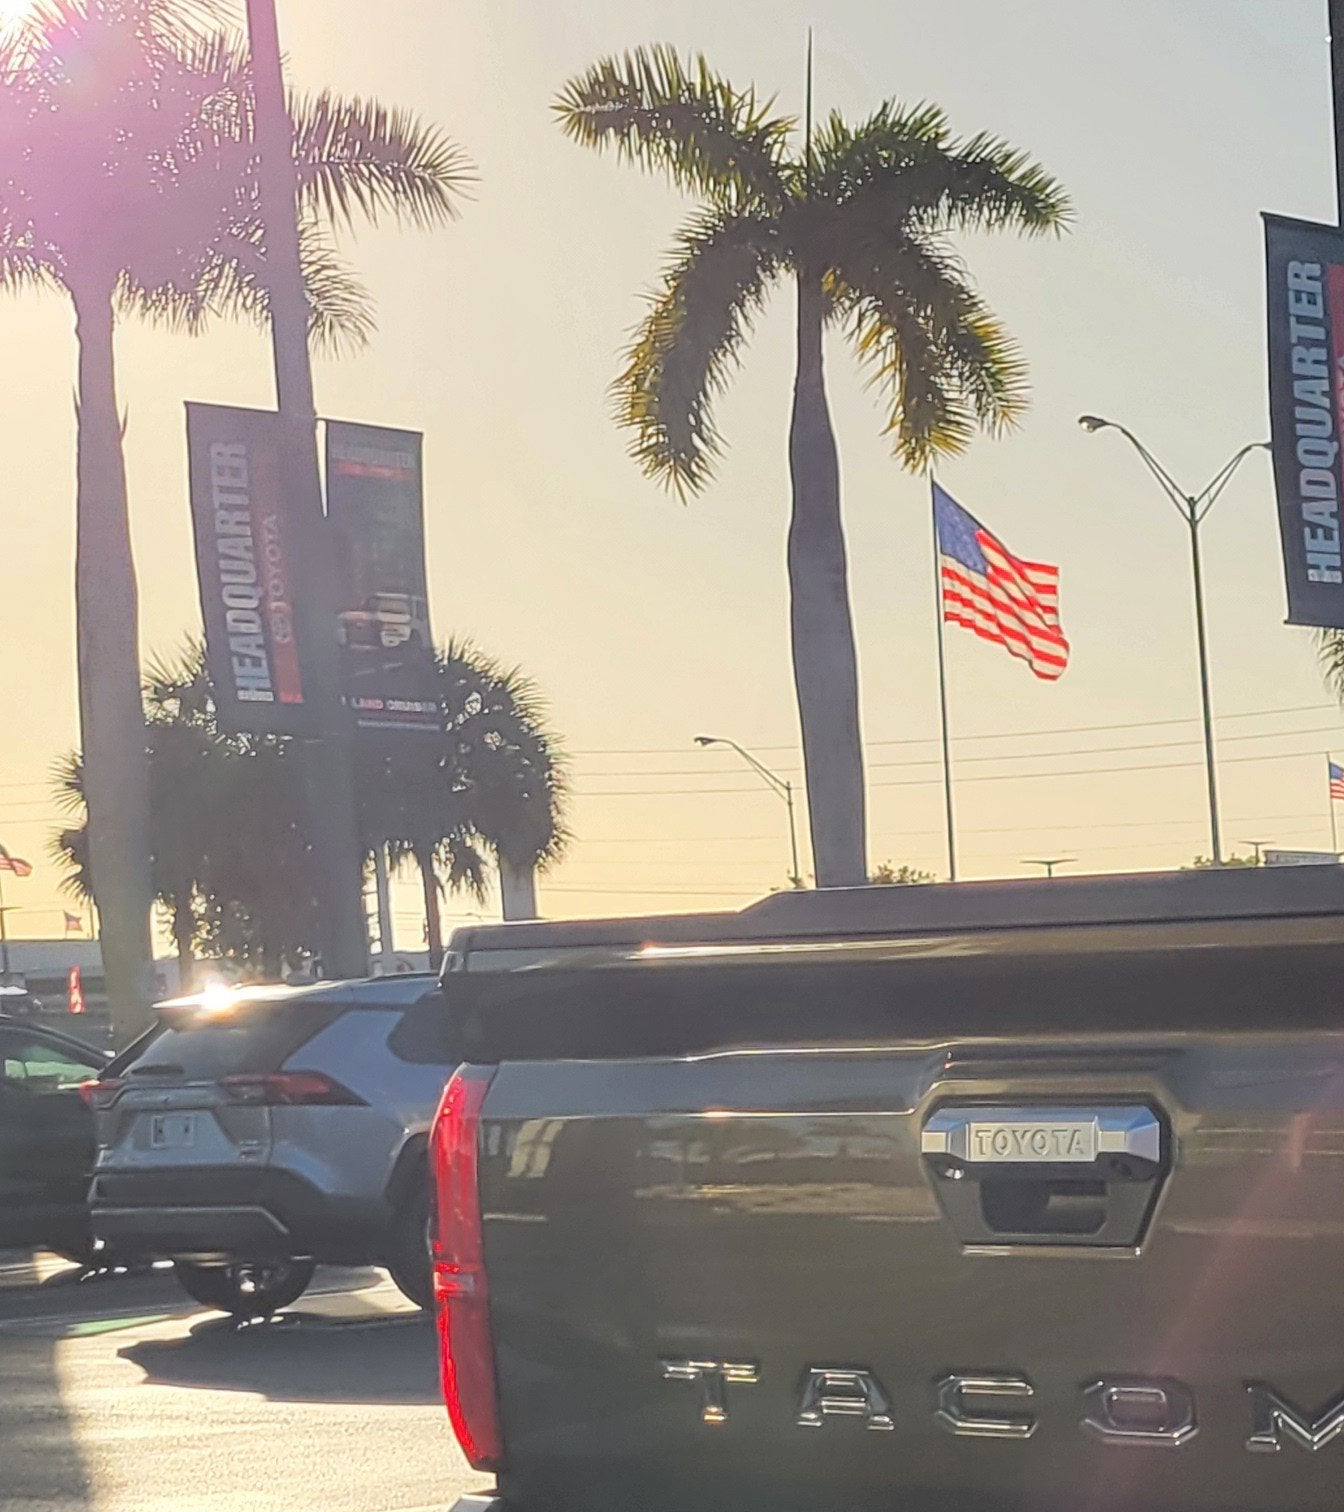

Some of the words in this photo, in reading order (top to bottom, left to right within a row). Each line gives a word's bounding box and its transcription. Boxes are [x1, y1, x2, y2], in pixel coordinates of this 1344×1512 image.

[1287, 260, 1343, 584] HEADQUARTER
[210, 441, 274, 702] HEADQUARTER
[261, 514, 286, 610] TOYOTA
[976, 1128, 1084, 1157] TOYOTA
